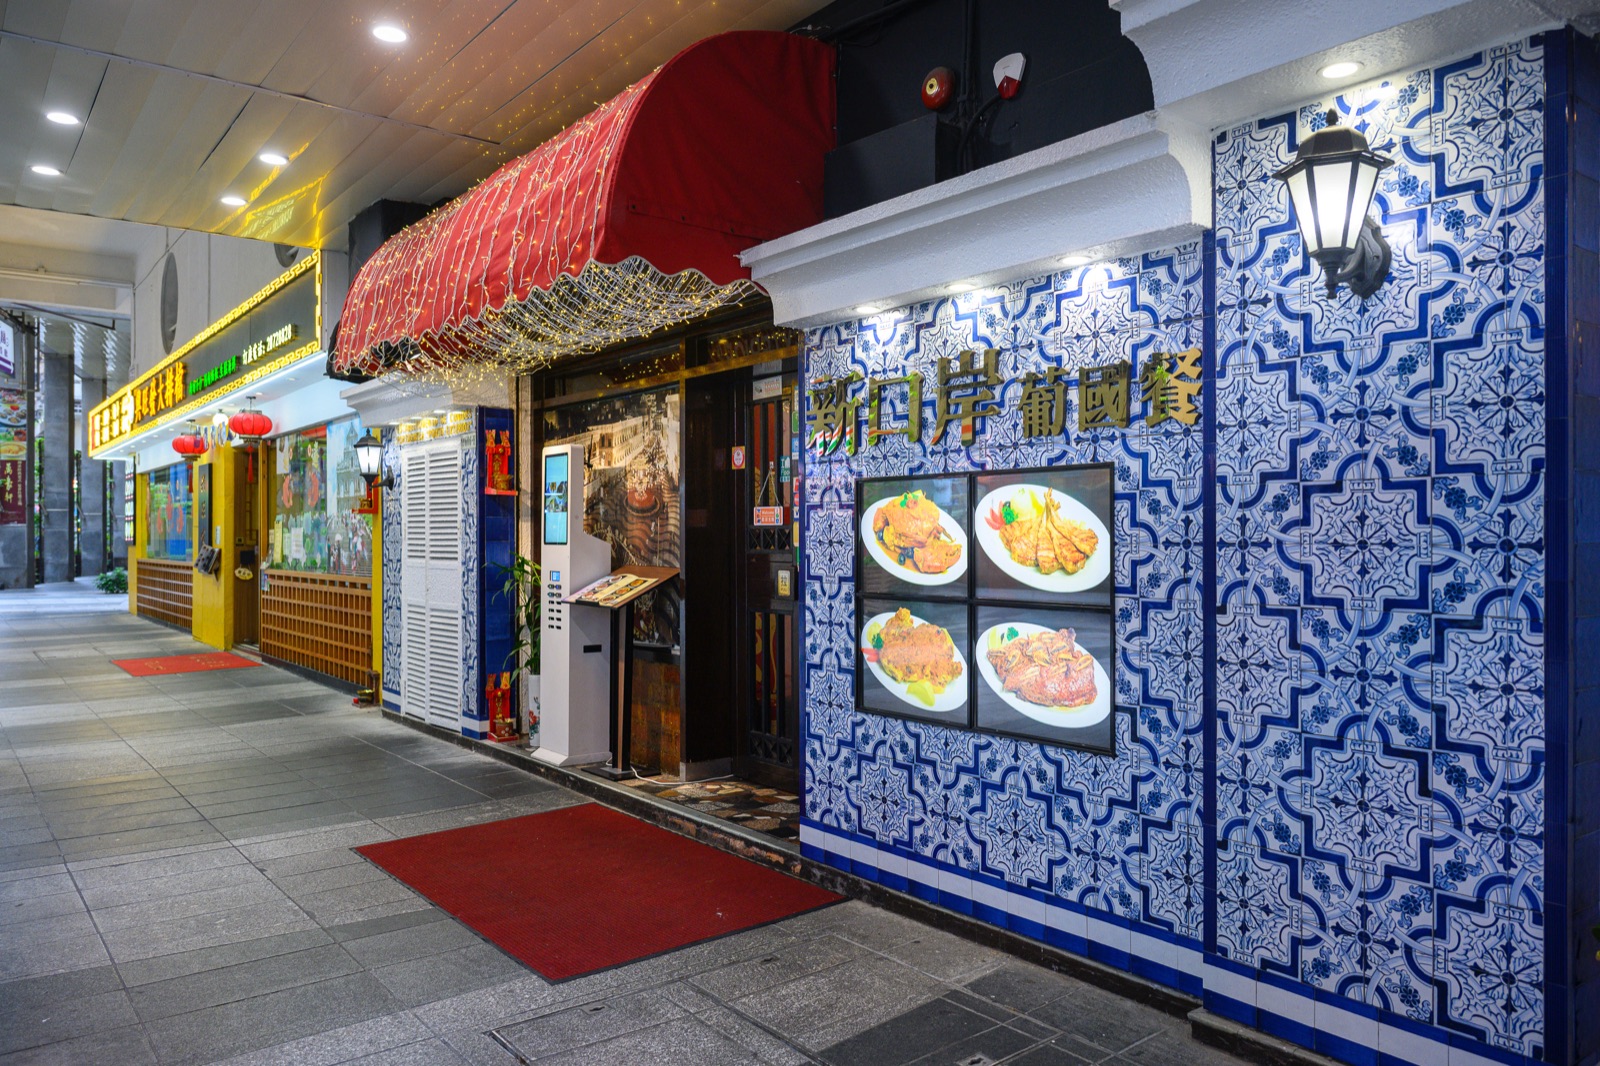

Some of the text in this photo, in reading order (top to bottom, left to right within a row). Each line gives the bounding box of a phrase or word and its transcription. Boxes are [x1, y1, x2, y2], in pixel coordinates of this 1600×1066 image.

[805, 348, 1202, 457] 新口岸葡國餐
